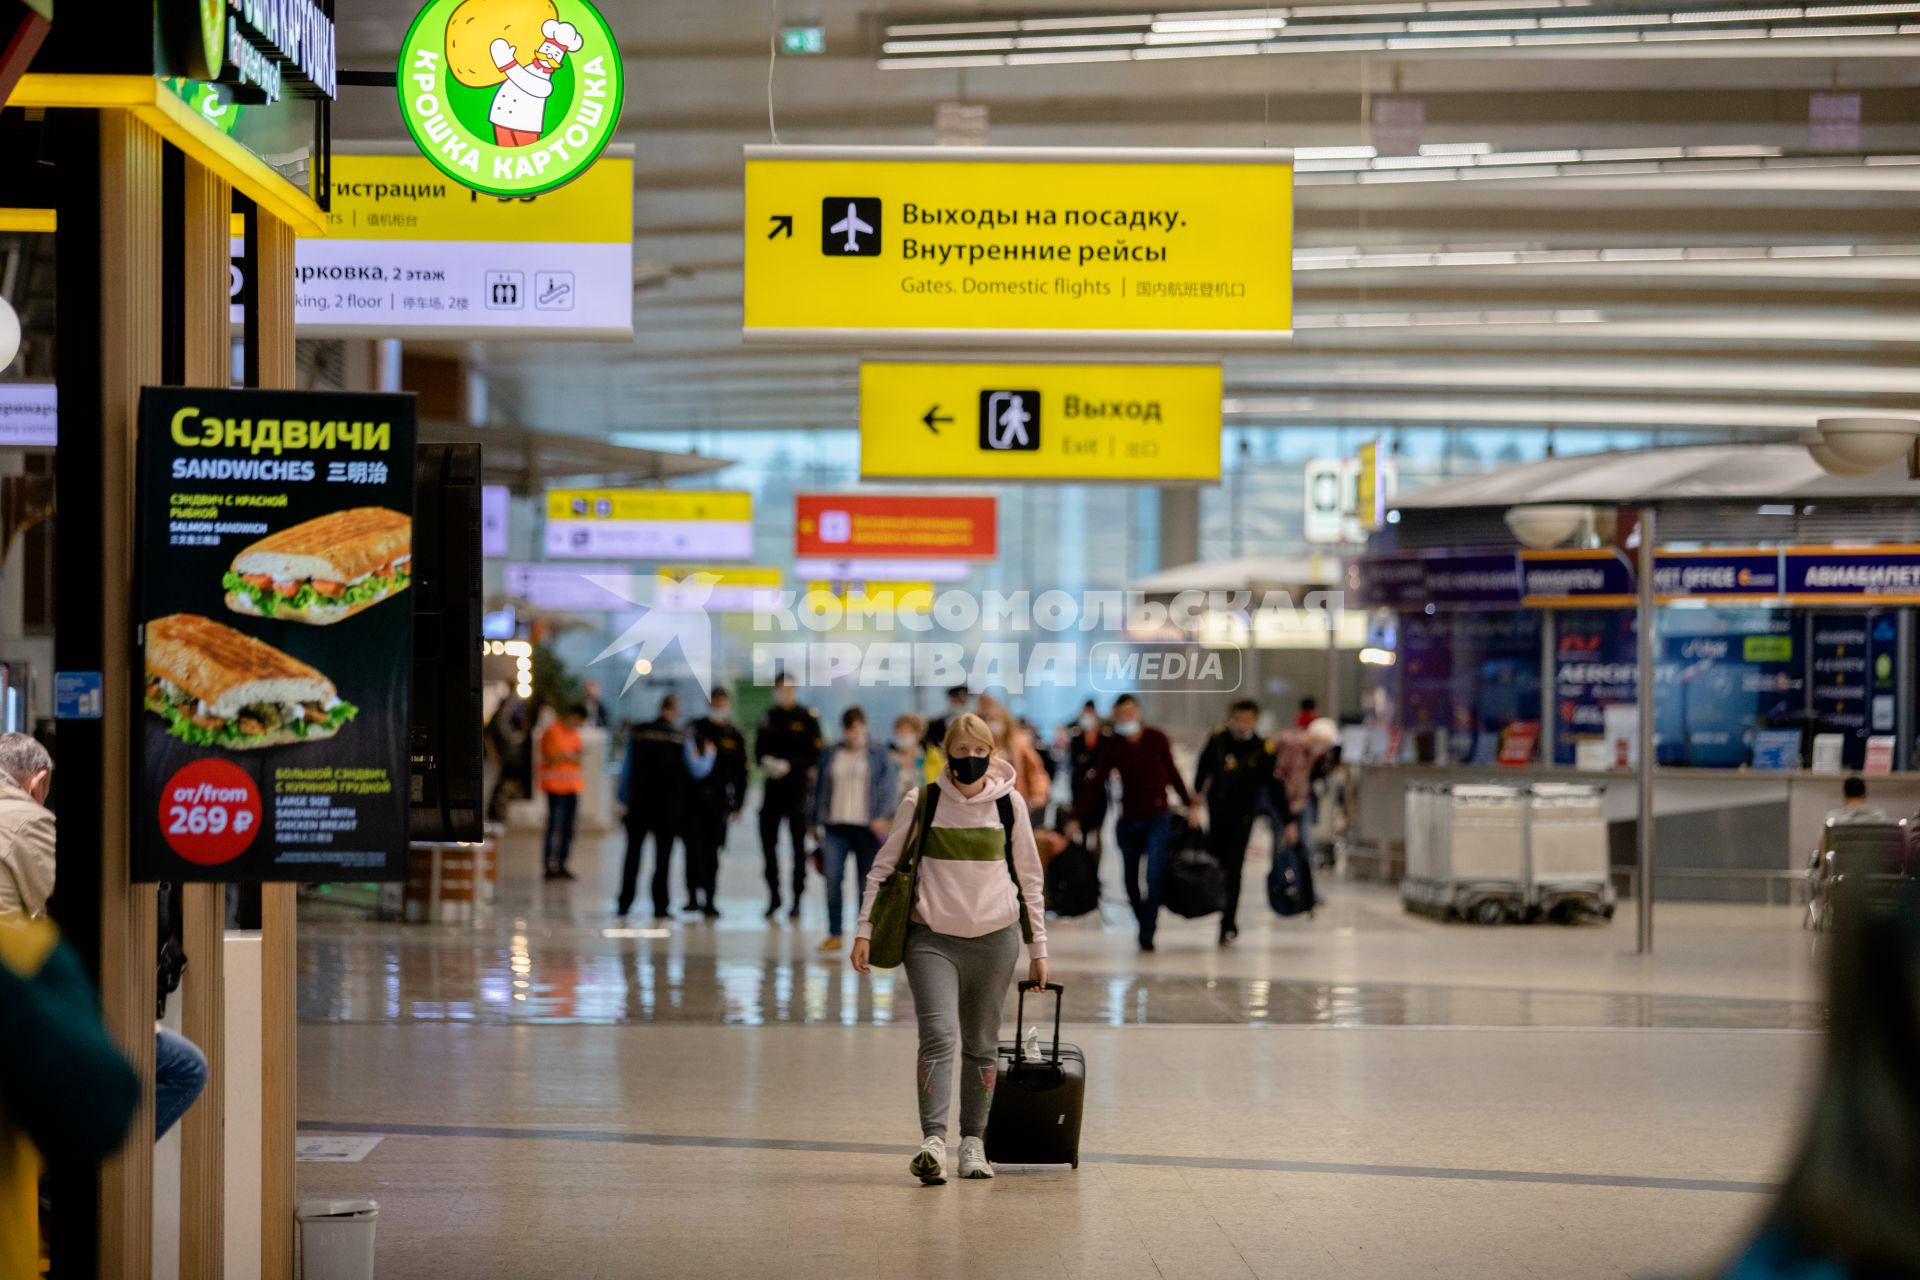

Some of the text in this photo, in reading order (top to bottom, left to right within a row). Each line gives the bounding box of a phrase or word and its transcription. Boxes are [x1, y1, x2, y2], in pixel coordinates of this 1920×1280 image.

[413, 49, 480, 173] КРОШКА
[493, 55, 607, 179] КАРТОШКА
[902, 204, 1187, 232] Выходы на посадку.
[902, 239, 1167, 267] Внутренние рейсы
[393, 268, 402, 280] 2
[406, 269, 446, 281] этаж
[901, 276, 1111, 299] Gates. Domestic flights
[335, 294, 344, 307] 2
[347, 294, 382, 308] floor
[1064, 395, 1163, 423] Выход
[170, 407, 391, 455] Сэндвичи
[1062, 437, 1097, 456] Exit
[172, 457, 316, 482] SANDWICHES
[326, 461, 389, 484] 三明治
[170, 494, 224, 506] СЭНДВИЧ
[235, 493, 288, 507] КРАСНОЙ
[169, 521, 268, 533] SALMON SANDWICH
[1682, 567, 1735, 587] OFFICE
[173, 783, 248, 803] от/from
[168, 806, 228, 834] 269
